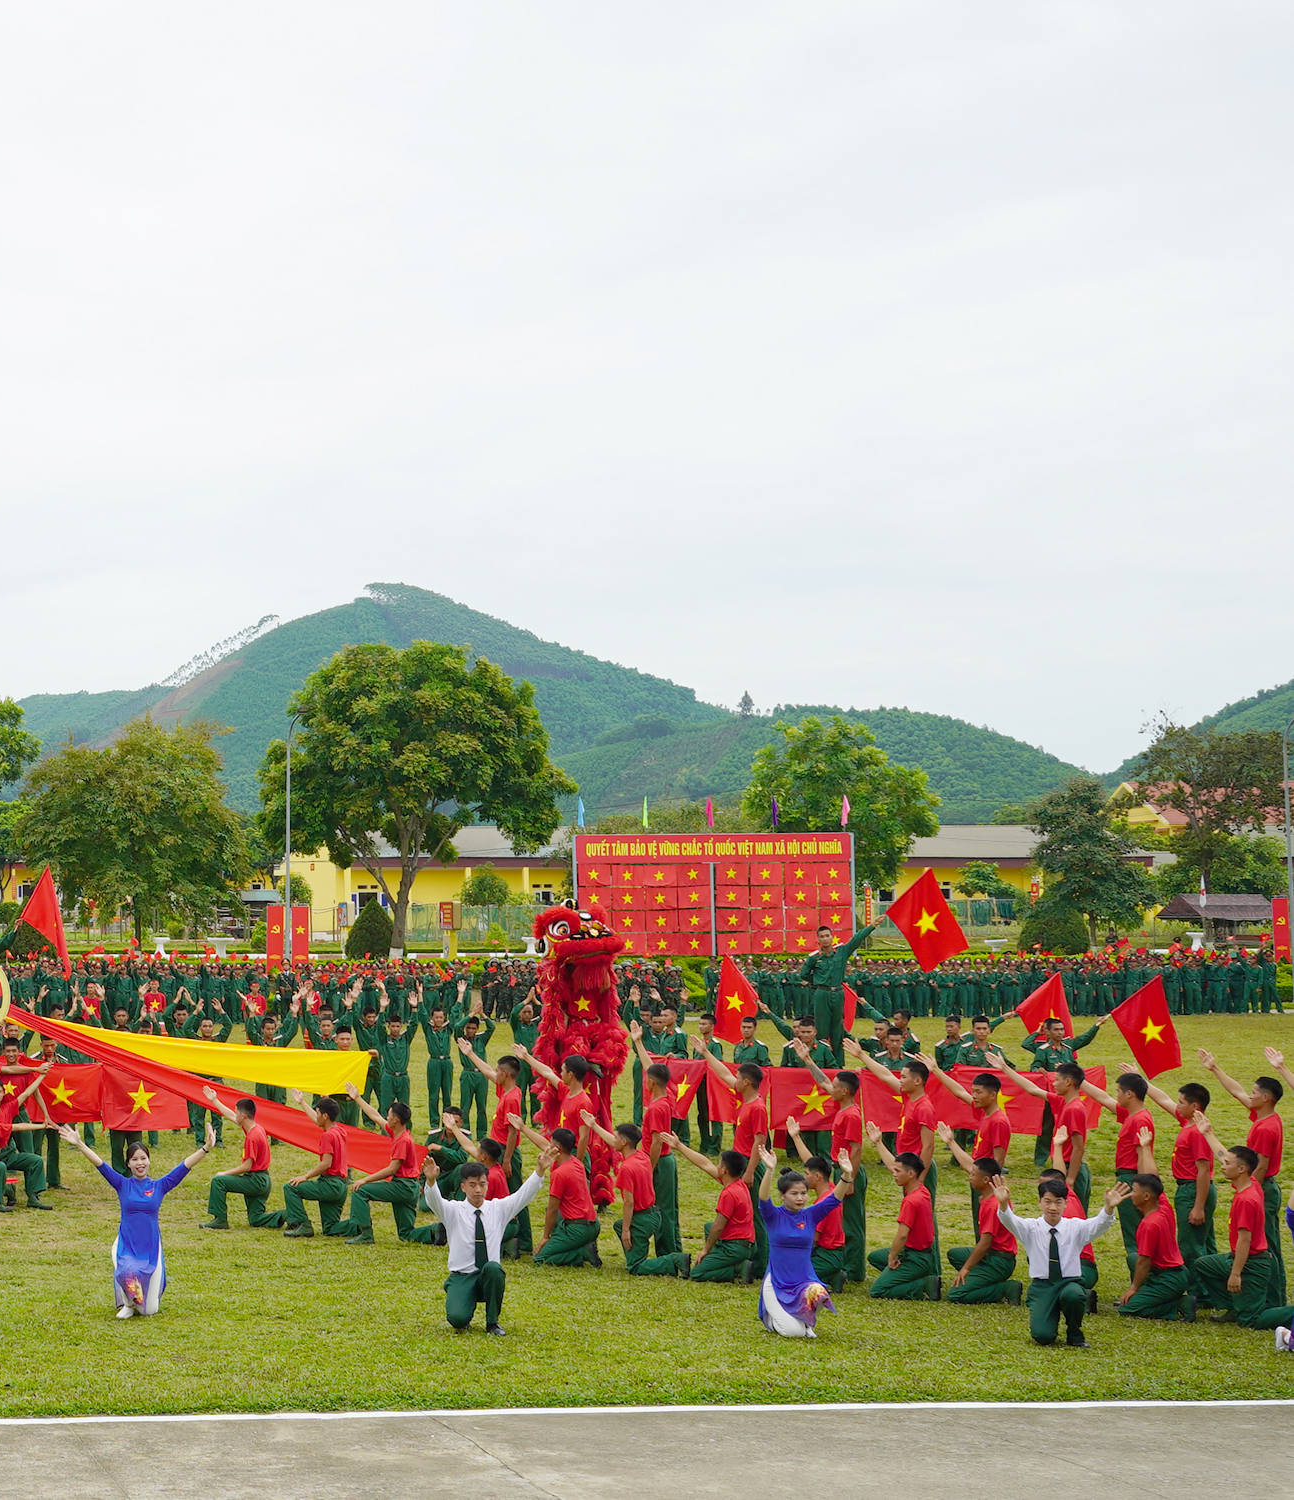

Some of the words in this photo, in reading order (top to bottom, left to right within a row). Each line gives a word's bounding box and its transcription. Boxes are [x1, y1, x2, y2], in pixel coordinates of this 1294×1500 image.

[586, 839, 610, 857] QUYẾT
[611, 840, 629, 856] TÂM
[630, 838, 646, 856] BẢO
[647, 840, 658, 859] VỆ
[659, 840, 680, 856] VỮNG
[681, 837, 703, 856] CHẮC
[704, 837, 714, 855] TỔ
[715, 838, 736, 857] QUỐC
[737, 839, 754, 858] VIỆT
[755, 841, 774, 855] NAM
[775, 839, 786, 855] XÃ
[787, 839, 801, 858] HỘI
[802, 837, 817, 855] CHỦ
[818, 838, 843, 855] NGHĨA
